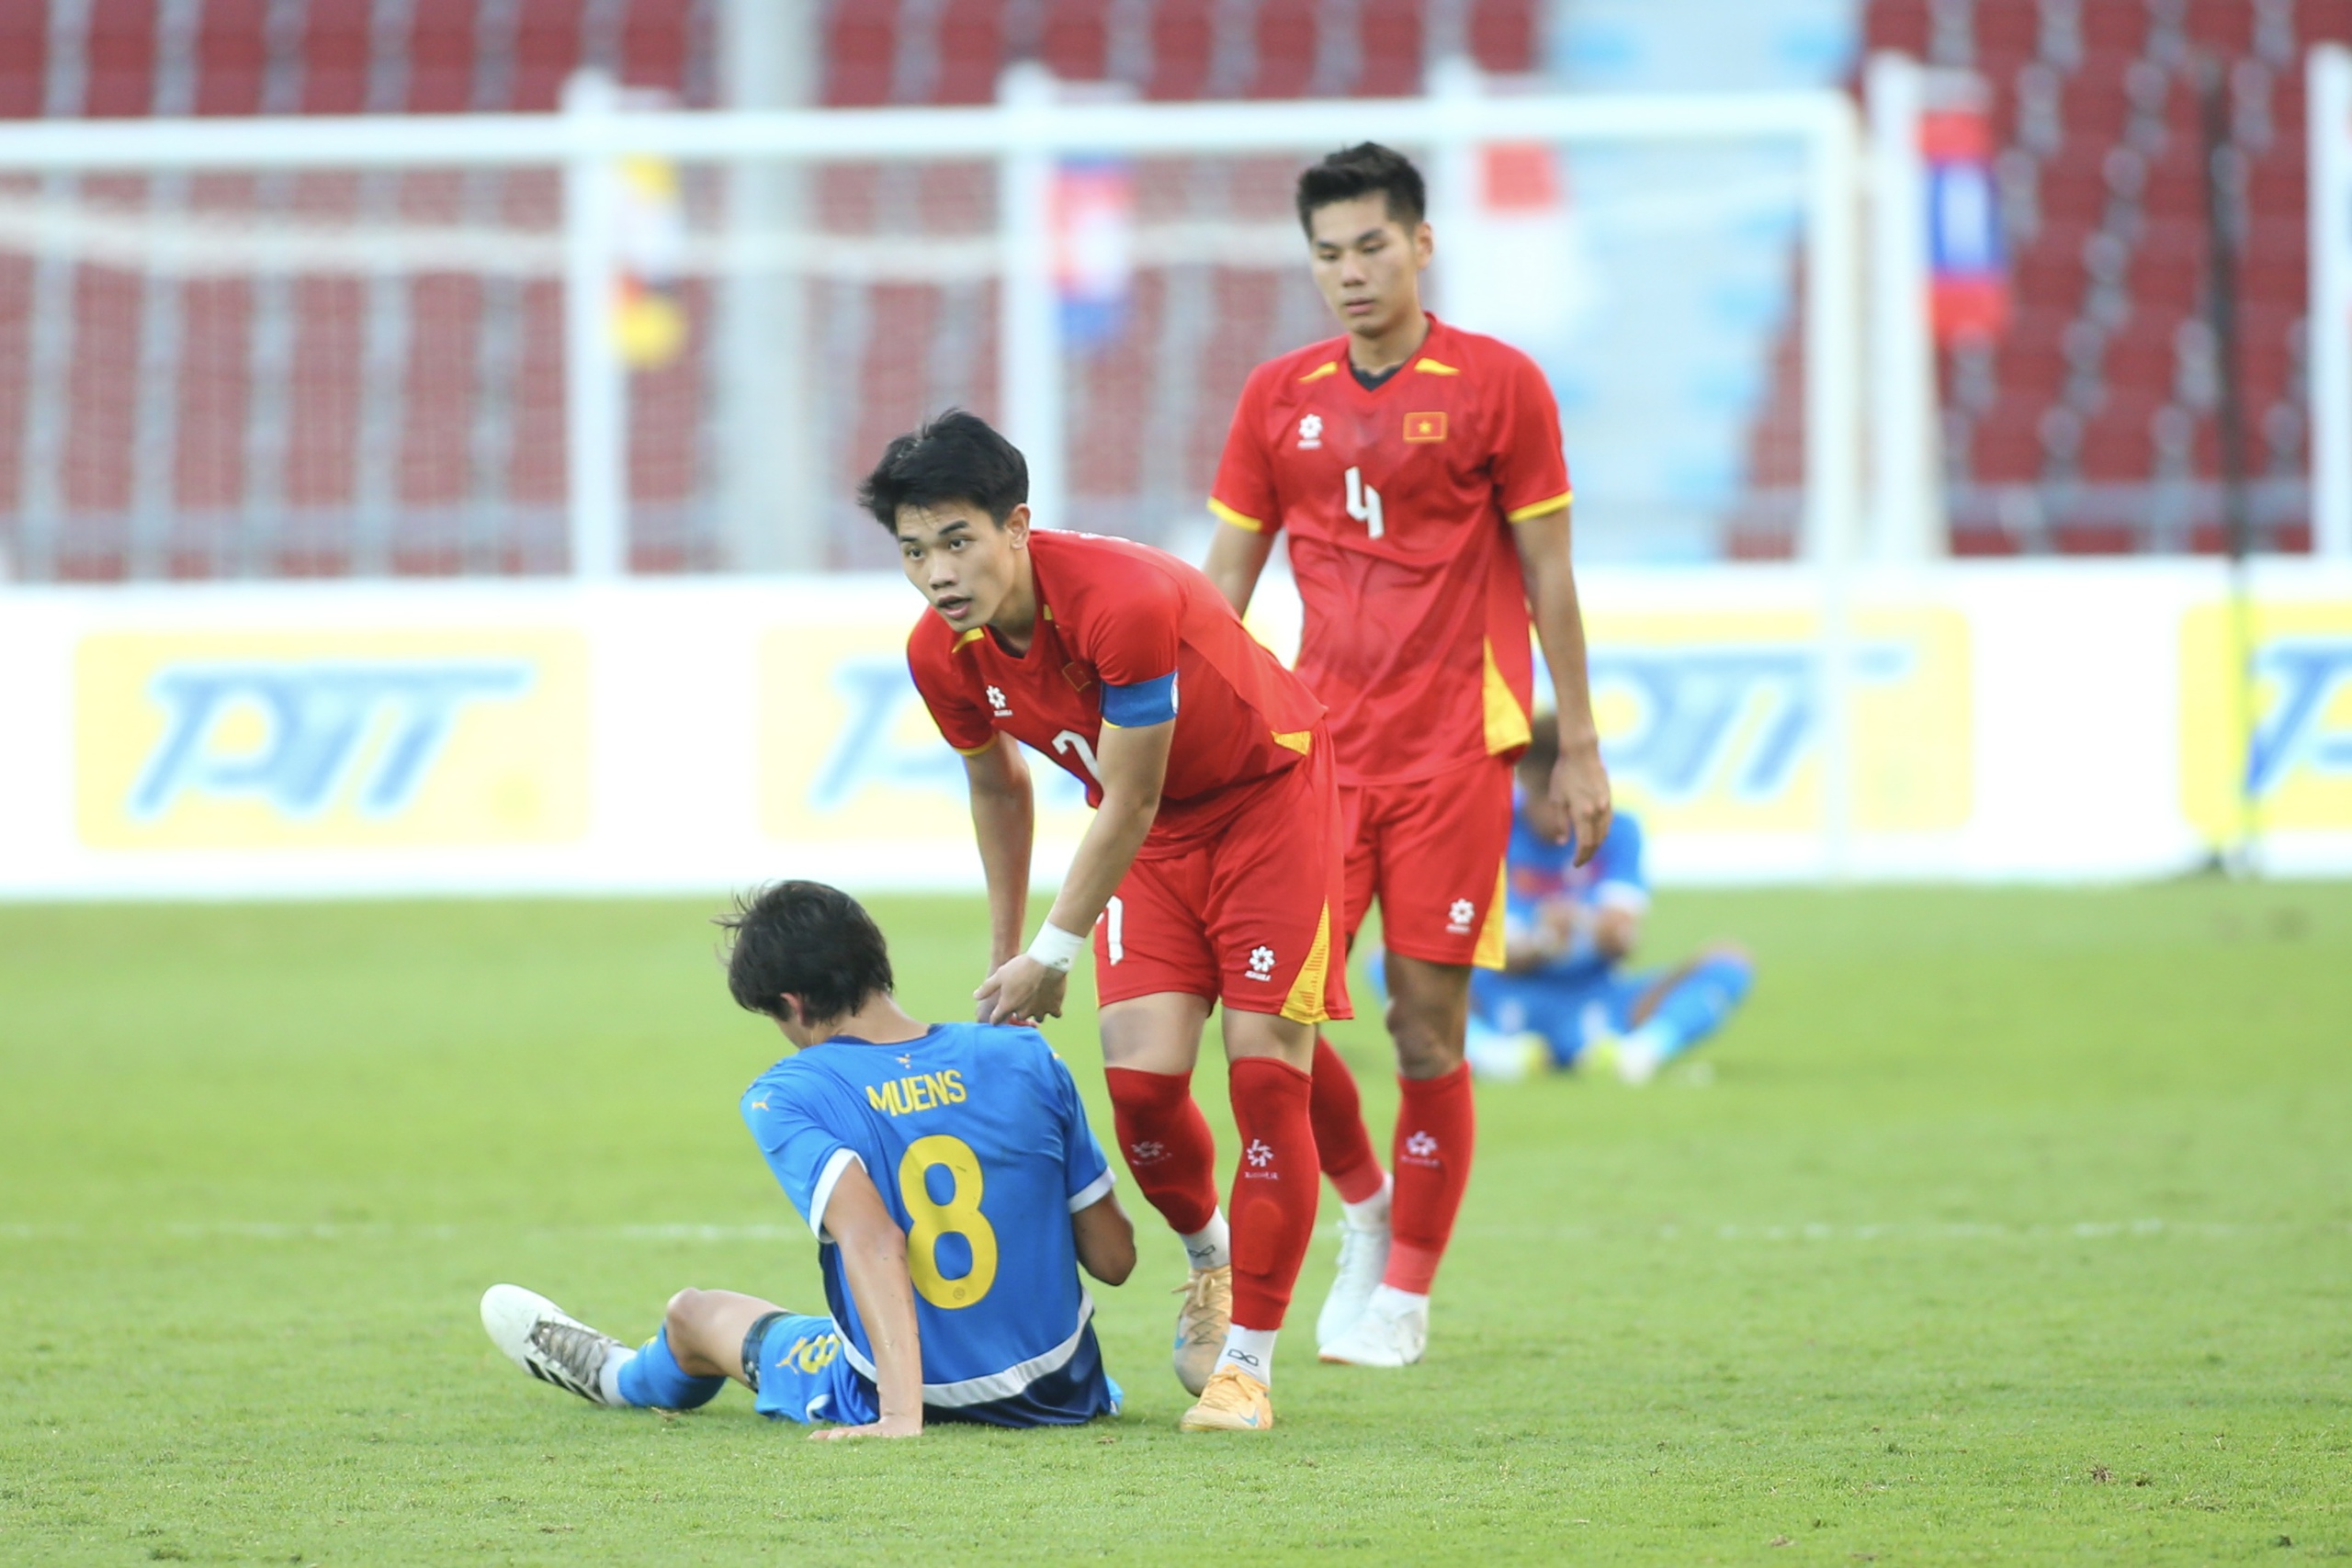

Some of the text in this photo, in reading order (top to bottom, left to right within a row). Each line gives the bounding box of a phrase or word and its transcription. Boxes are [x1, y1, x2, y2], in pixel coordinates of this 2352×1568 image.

[1344, 466, 1385, 540] 4
[129, 659, 537, 819] PTT
[865, 1069, 967, 1116] MUENS
[899, 1134, 998, 1309] 8
[798, 1333, 842, 1374] 8
